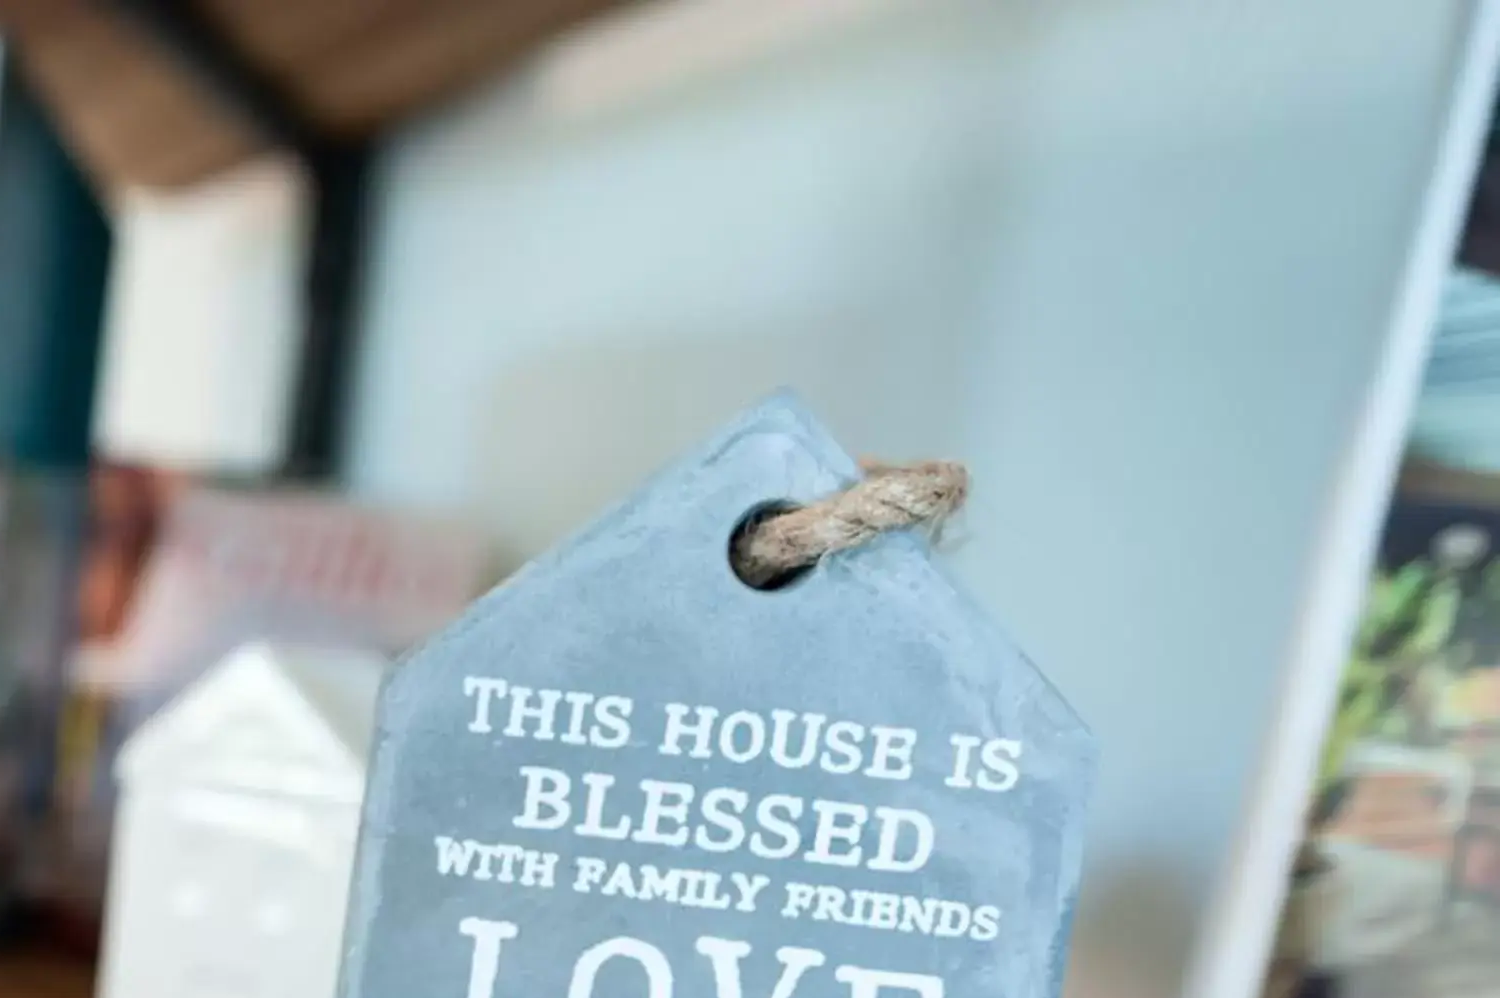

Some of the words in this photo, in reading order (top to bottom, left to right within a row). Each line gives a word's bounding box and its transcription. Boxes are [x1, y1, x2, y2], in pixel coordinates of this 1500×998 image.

[464, 677, 633, 748] THIS
[659, 703, 916, 780] HOUSE
[945, 733, 1021, 791] IS
[513, 766, 935, 873] BLESSED
[434, 837, 558, 887] WITH
[573, 857, 770, 911] FAMILY
[783, 883, 1000, 941] FRIENDS
